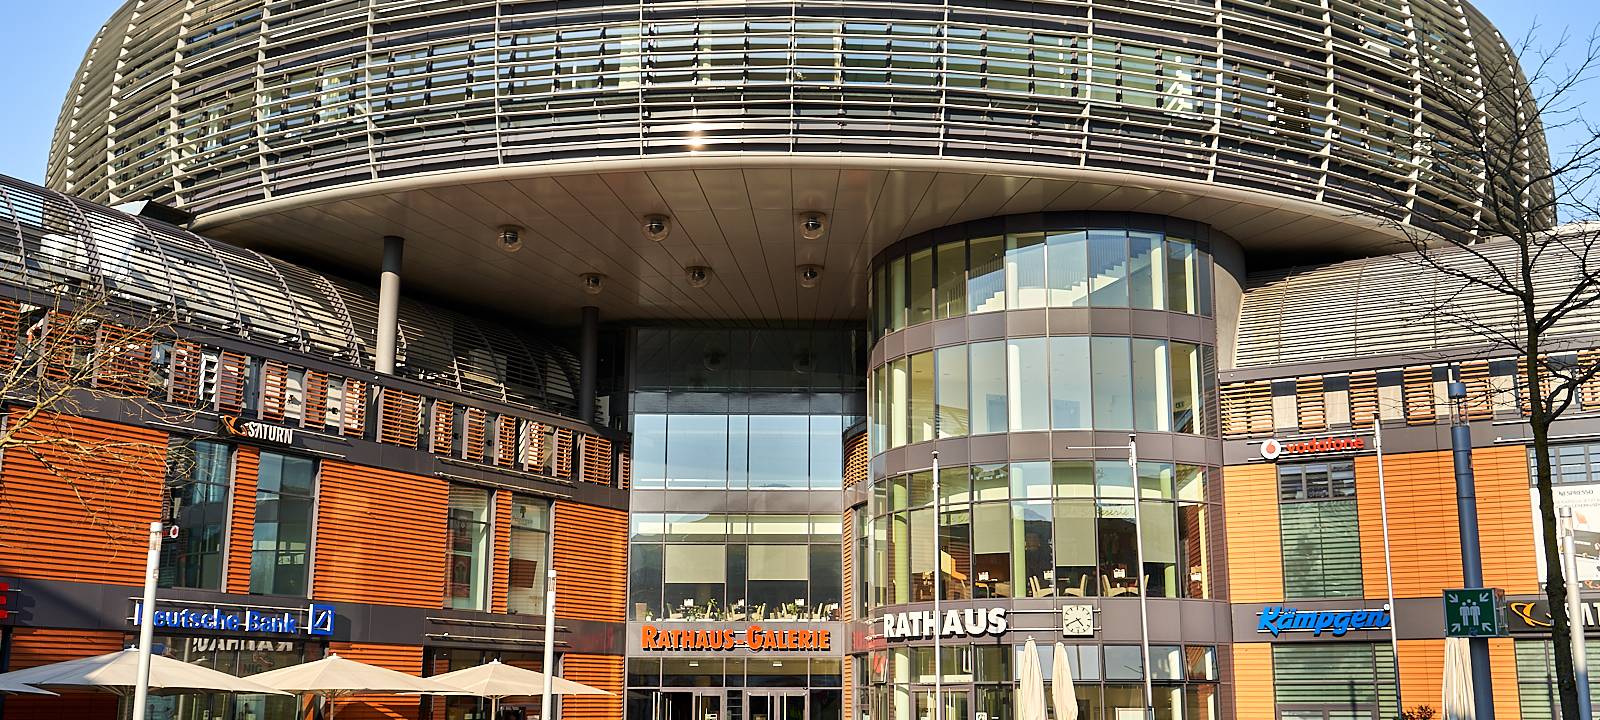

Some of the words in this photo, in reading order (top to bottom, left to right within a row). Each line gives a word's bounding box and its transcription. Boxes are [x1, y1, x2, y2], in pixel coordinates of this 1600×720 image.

[248, 421, 293, 444] SATURN
[1286, 437, 1365, 454] vodafone
[245, 610, 298, 634] Bank
[884, 607, 1008, 638] RATHAUS
[1257, 606, 1391, 637] Kämpgen
